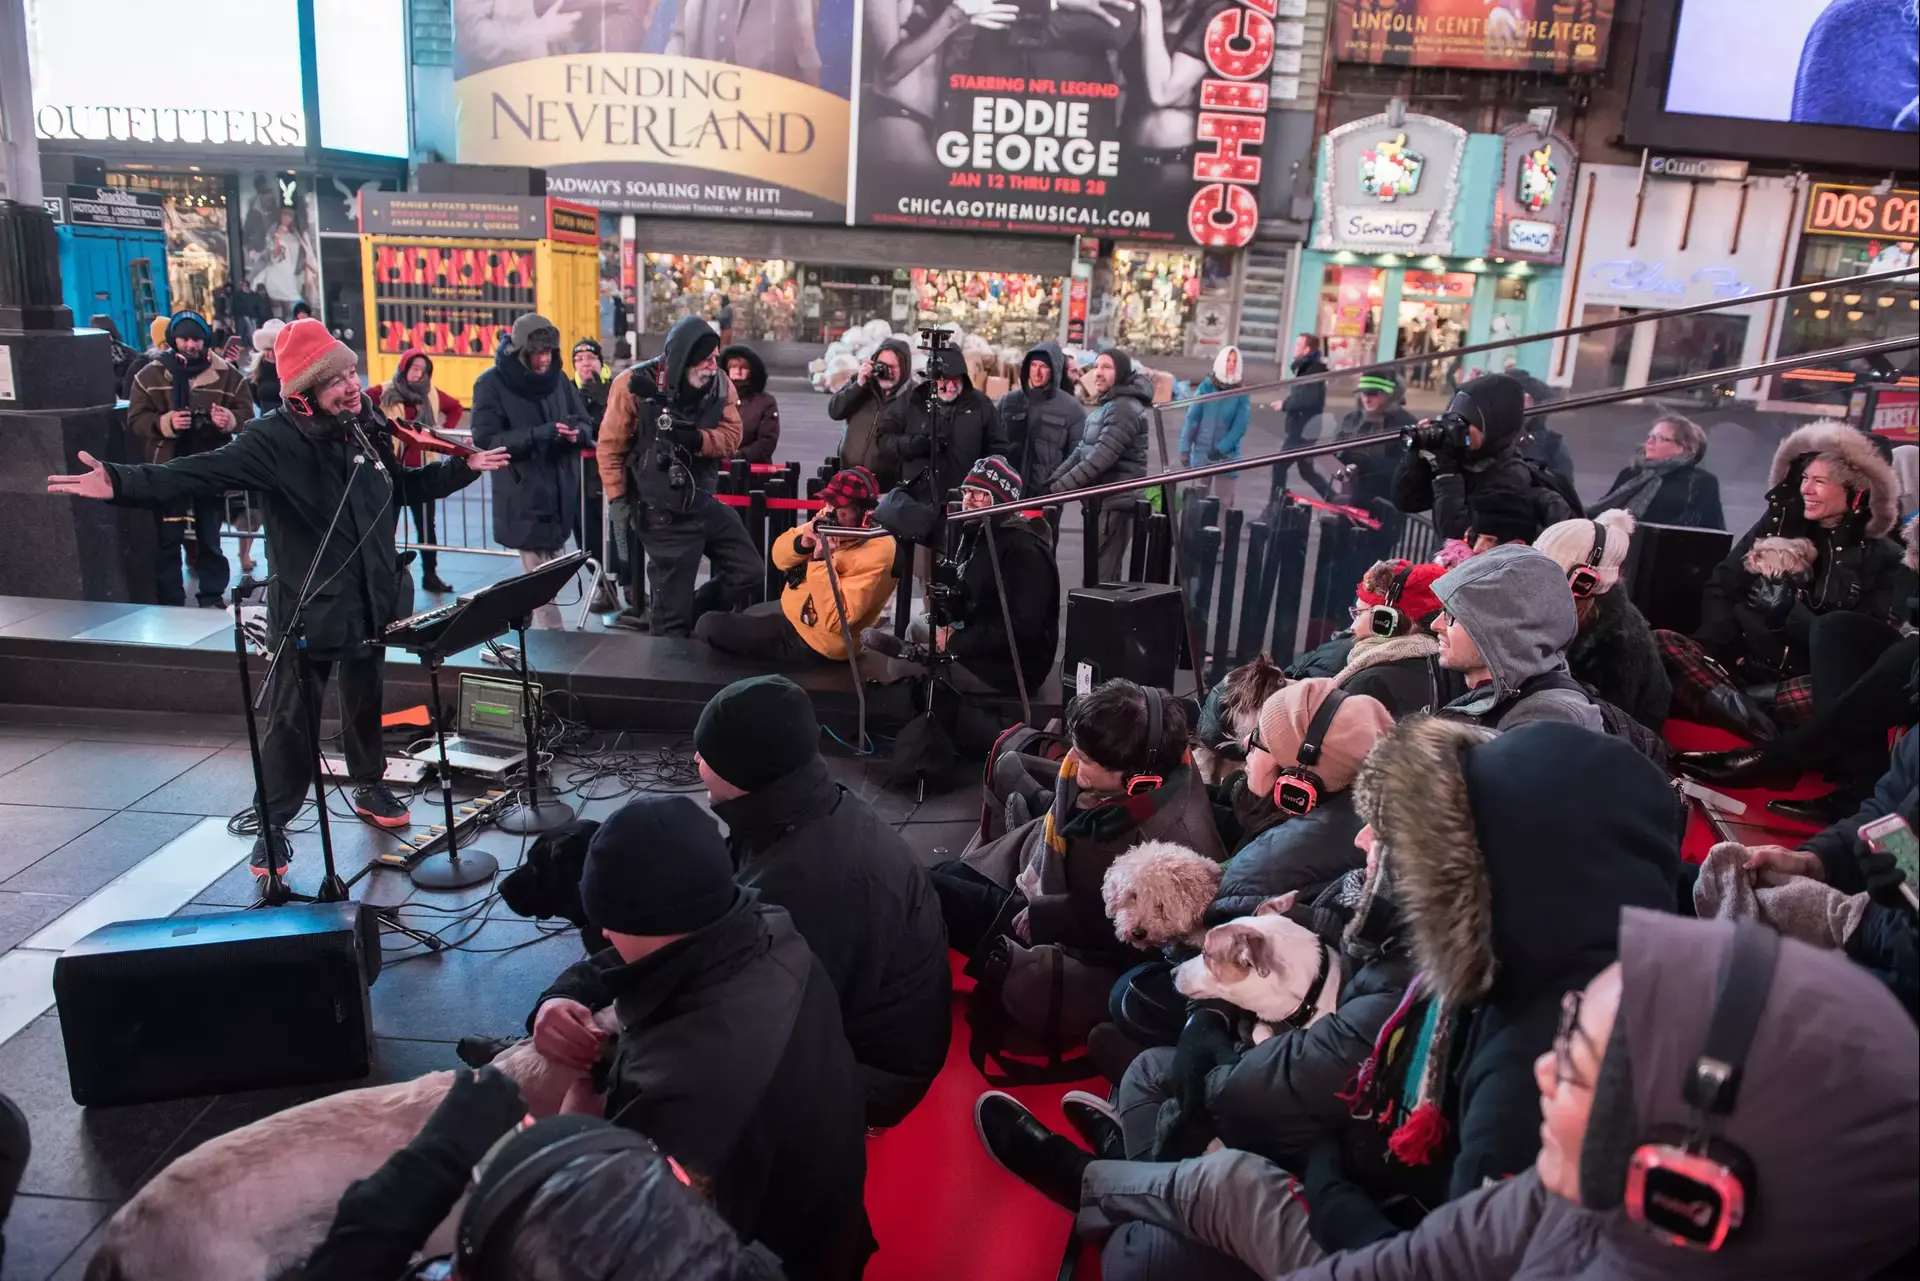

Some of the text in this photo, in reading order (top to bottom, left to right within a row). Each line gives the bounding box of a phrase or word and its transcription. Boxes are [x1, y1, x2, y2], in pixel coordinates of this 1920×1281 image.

[1352, 11, 1597, 42] LINCOLN CENT THEATER
[564, 63, 742, 102] FINDING
[949, 74, 1120, 98] STARRING NFL LEGEND
[37, 104, 300, 147] OUTFITTERS
[489, 91, 816, 158] NEVERLAND
[972, 96, 1090, 138] EDDIE
[1187, 0, 1278, 247] CHIC
[936, 130, 1121, 177] GEORGE
[545, 176, 781, 204] OADWAY'S SOARING NEW HIT!
[949, 172, 1107, 196] JAN 12 THRU FEB 28
[111, 207, 141, 218] LOBSTER
[898, 197, 1150, 228] CHICAGOTHEMUSICAL.COM
[1813, 191, 1877, 231] DOS
[1348, 216, 1417, 238] Sanrio
[1511, 224, 1550, 246] Sanrio
